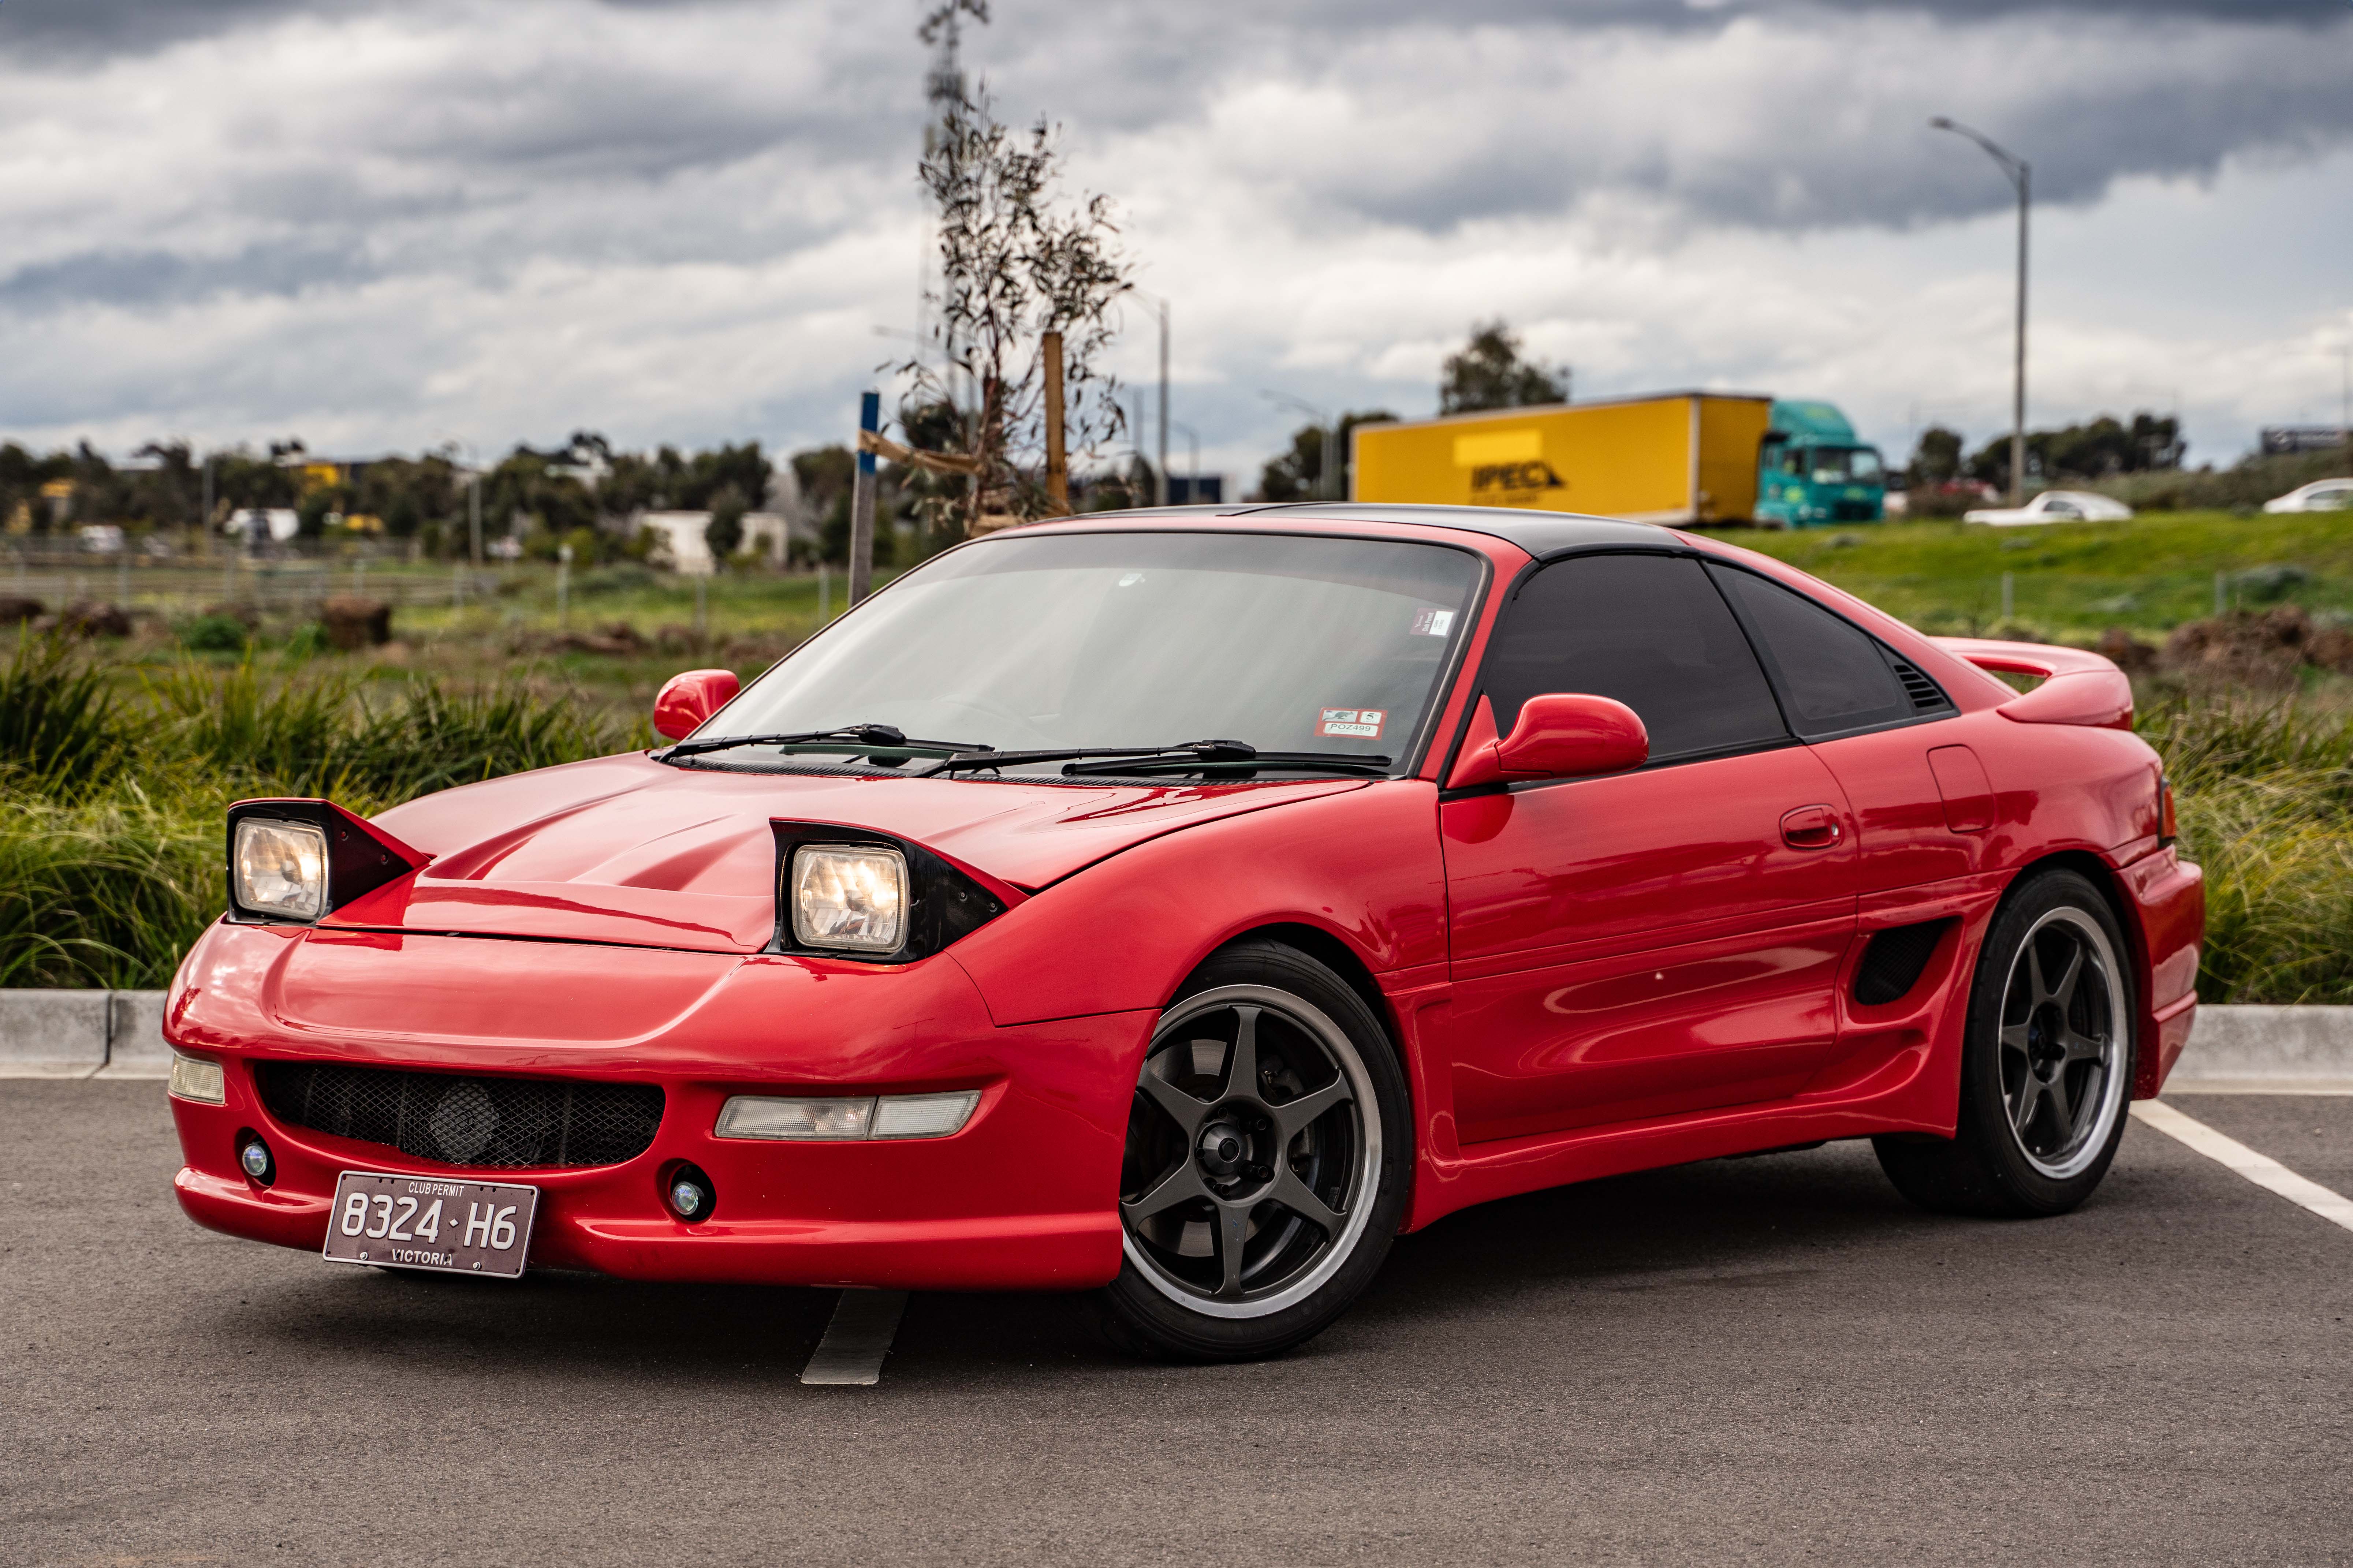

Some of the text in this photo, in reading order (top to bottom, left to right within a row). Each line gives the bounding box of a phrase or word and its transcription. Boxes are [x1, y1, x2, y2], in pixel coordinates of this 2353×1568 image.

[409, 1181, 465, 1197] CLUB PERMIT
[392, 1248, 452, 1266] VICTORIA
[1240, 1302, 1321, 1337] YOKOHAMA
